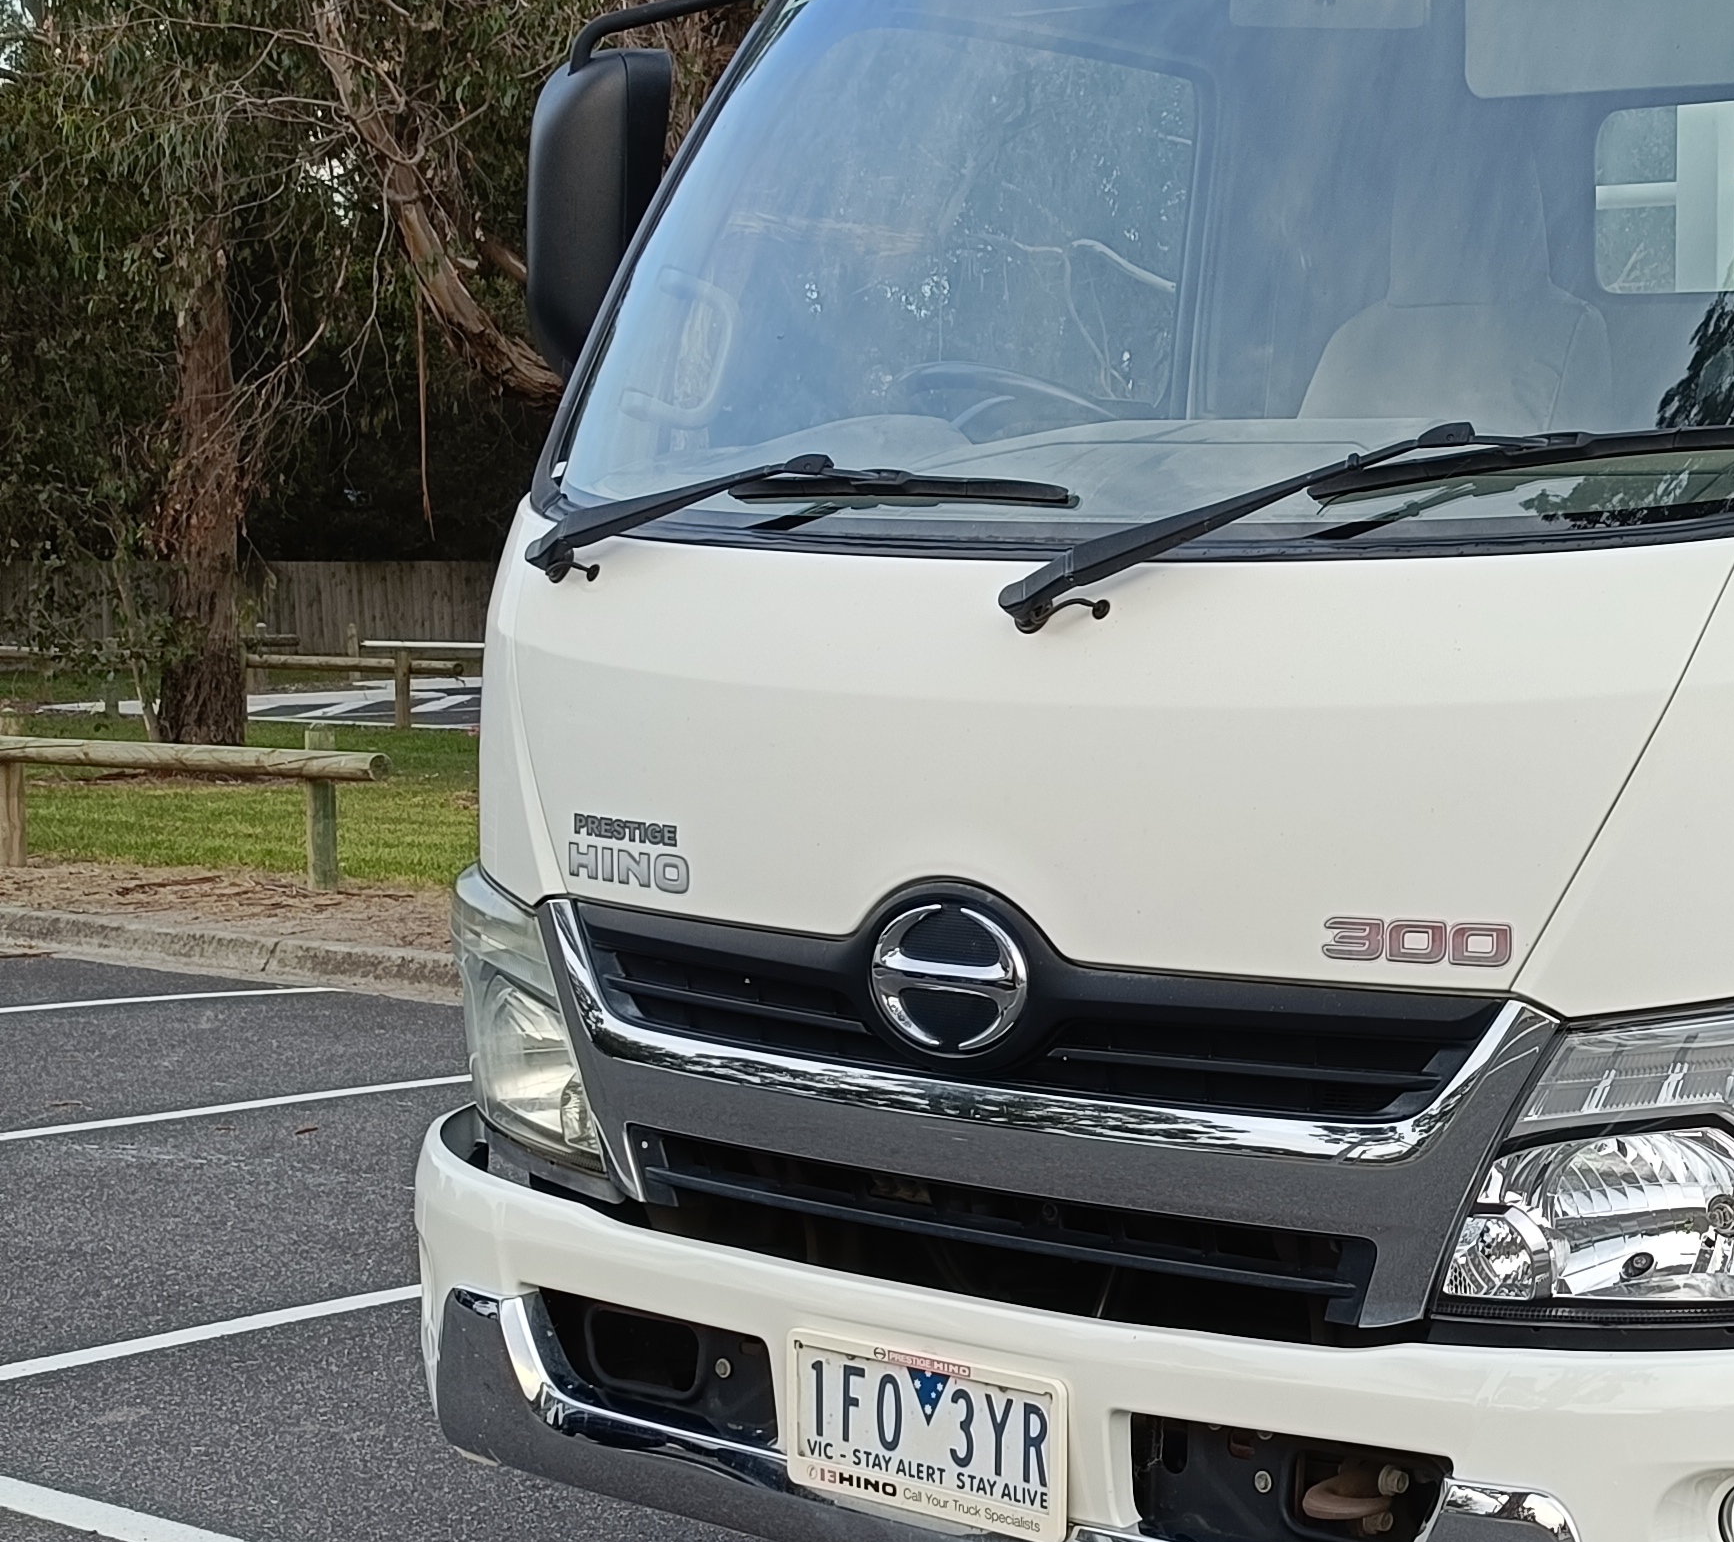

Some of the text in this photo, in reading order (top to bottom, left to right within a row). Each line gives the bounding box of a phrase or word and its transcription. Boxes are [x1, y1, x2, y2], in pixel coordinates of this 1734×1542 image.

[573, 812, 677, 847] PRESTIGE
[568, 841, 690, 895] HINO
[1321, 916, 1512, 967] 300
[889, 1351, 970, 1376] PRESTIGE HINO
[807, 1438, 833, 1460] VIC
[852, 1448, 892, 1473] STAY
[896, 1458, 946, 1485] ALERT
[956, 1472, 997, 1497] STAY
[1001, 1482, 1048, 1510] ALIVE
[903, 1486, 922, 1503] Call
[925, 1492, 949, 1510] Your
[952, 1498, 981, 1518] Truck
[984, 1507, 1041, 1533] Specialists
